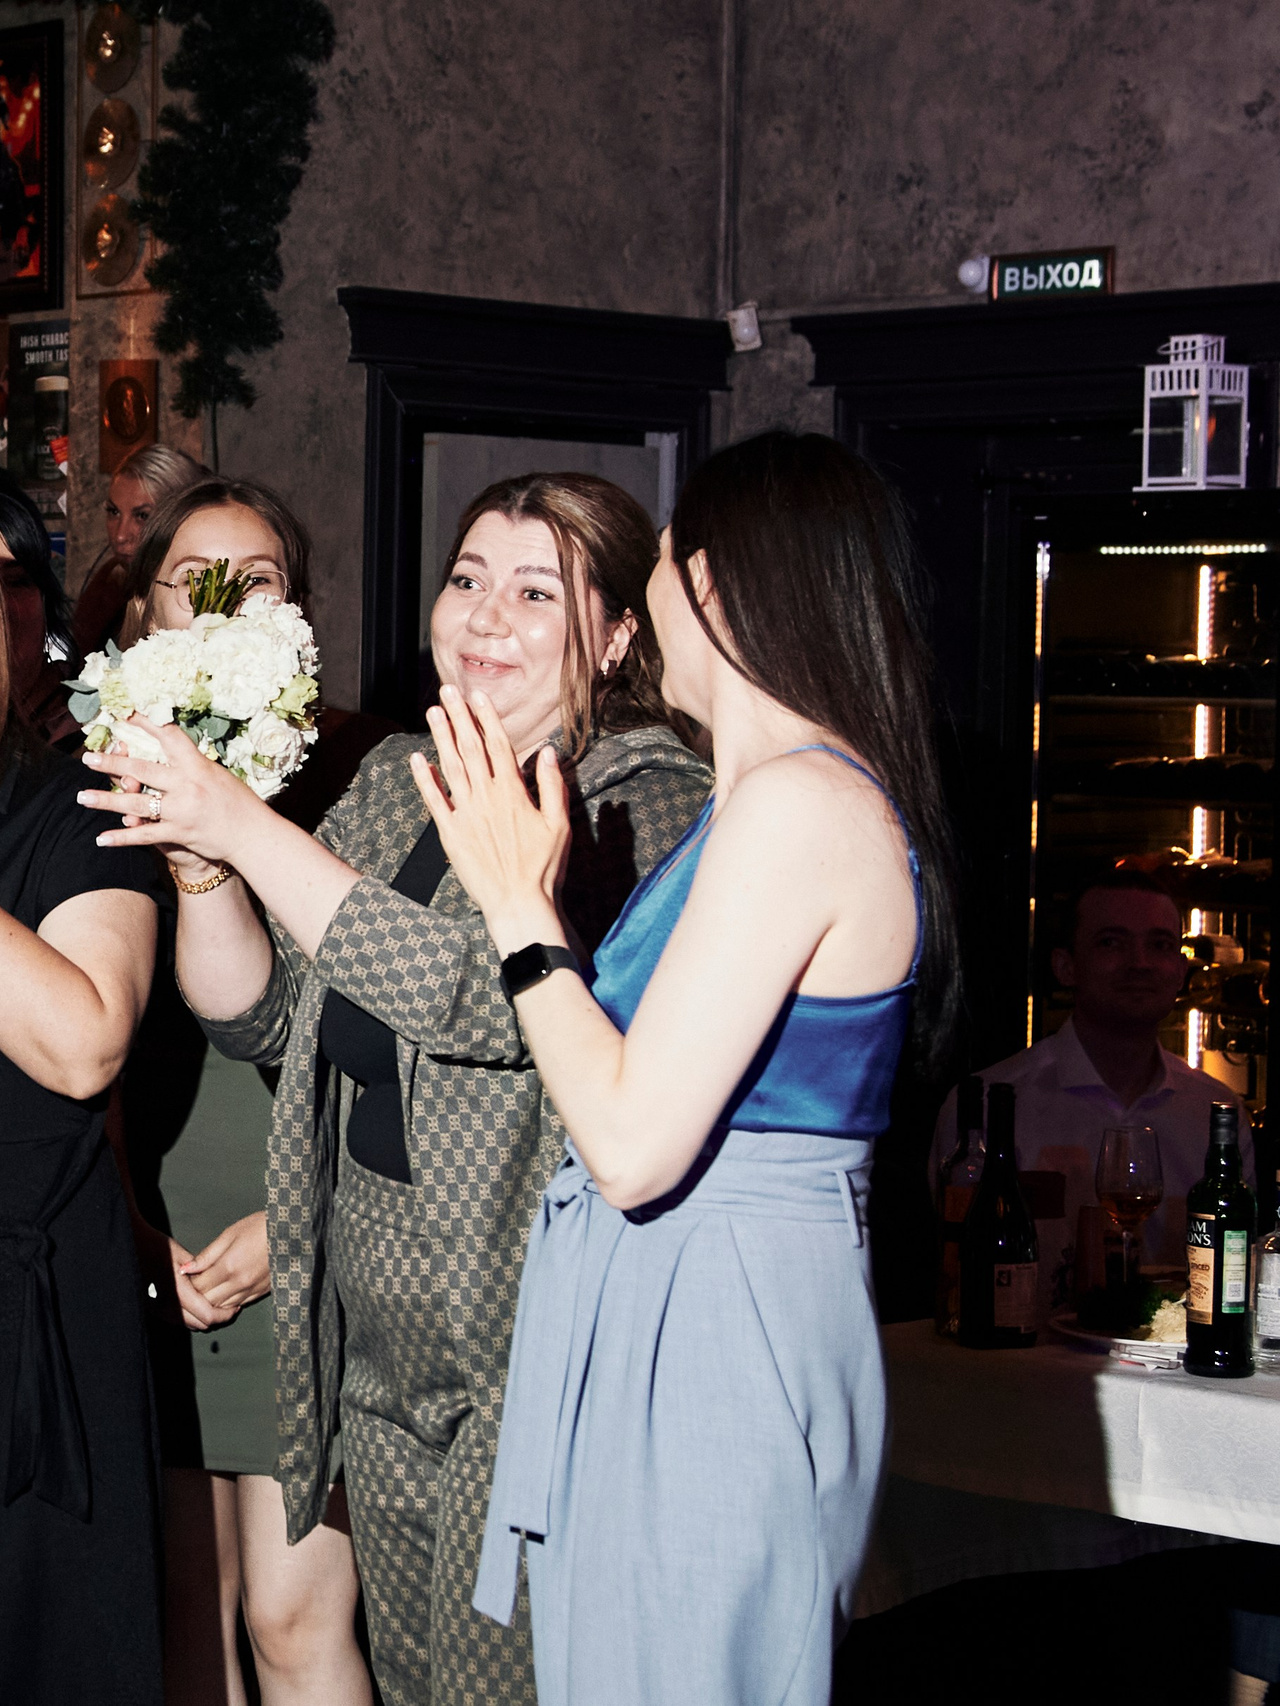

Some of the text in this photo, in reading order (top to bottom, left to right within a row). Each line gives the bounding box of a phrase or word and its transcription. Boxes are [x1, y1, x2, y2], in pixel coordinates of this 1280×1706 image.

[1004, 259, 1101, 292] ВЫХОД
[20, 335, 39, 349] IRISH
[25, 351, 53, 364] SMOOTH
